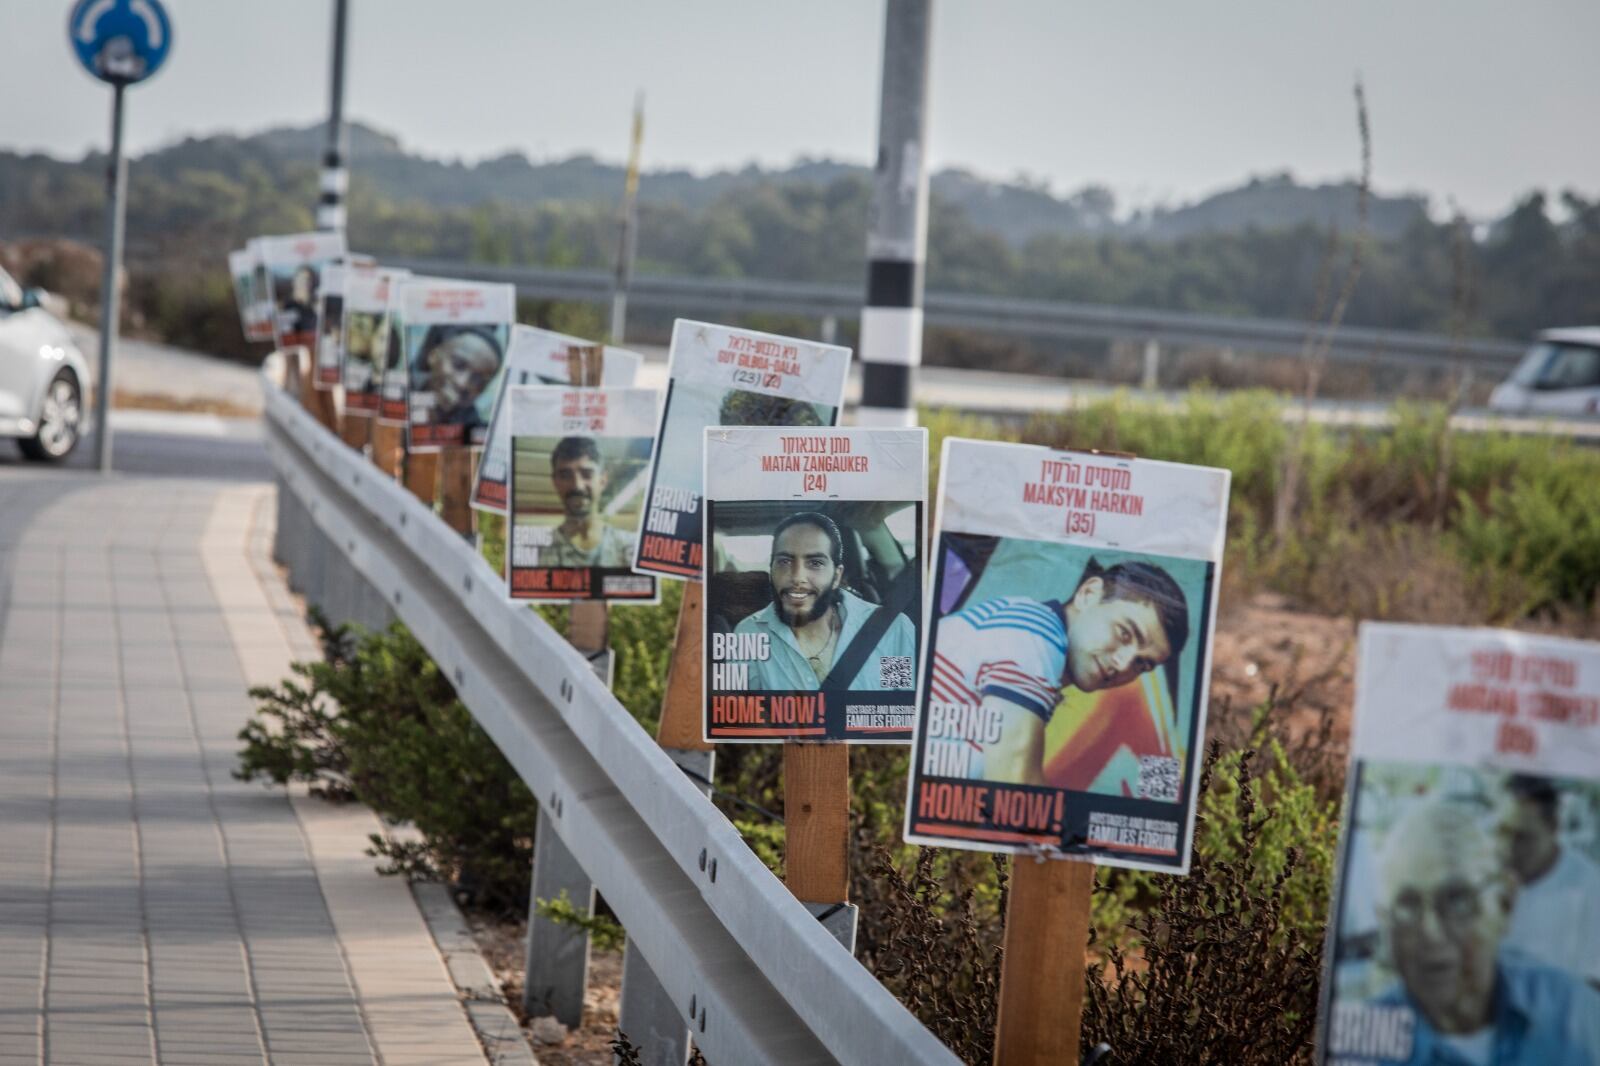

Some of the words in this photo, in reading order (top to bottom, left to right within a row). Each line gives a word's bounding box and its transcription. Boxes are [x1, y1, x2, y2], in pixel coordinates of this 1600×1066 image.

[733, 369, 761, 386] (23)
[830, 437, 850, 455] מתן
[762, 456, 800, 472] MATAN
[803, 456, 868, 472] ZANGAUKER
[1040, 460, 1081, 484] הרקין
[803, 474, 827, 492] (24)
[1084, 466, 1131, 491] מקסים
[652, 487, 698, 513] BRING
[1023, 482, 1086, 509] MAKSYM
[1090, 491, 1144, 516] HARKIN
[647, 508, 679, 535] HIM
[1065, 510, 1096, 536] (35)
[643, 535, 688, 563] HOME
[712, 632, 771, 661] BRING
[712, 663, 749, 690] HIM
[712, 695, 765, 724] HOME
[770, 692, 826, 724] NOW!
[846, 715, 884, 728] FAMILIES
[927, 700, 1003, 744] BRING
[922, 741, 971, 780] HIM
[918, 782, 989, 824] HOME
[992, 790, 1064, 832] NOW!
[1088, 823, 1137, 844] FAMILIES
[1138, 829, 1178, 850] FORUM
